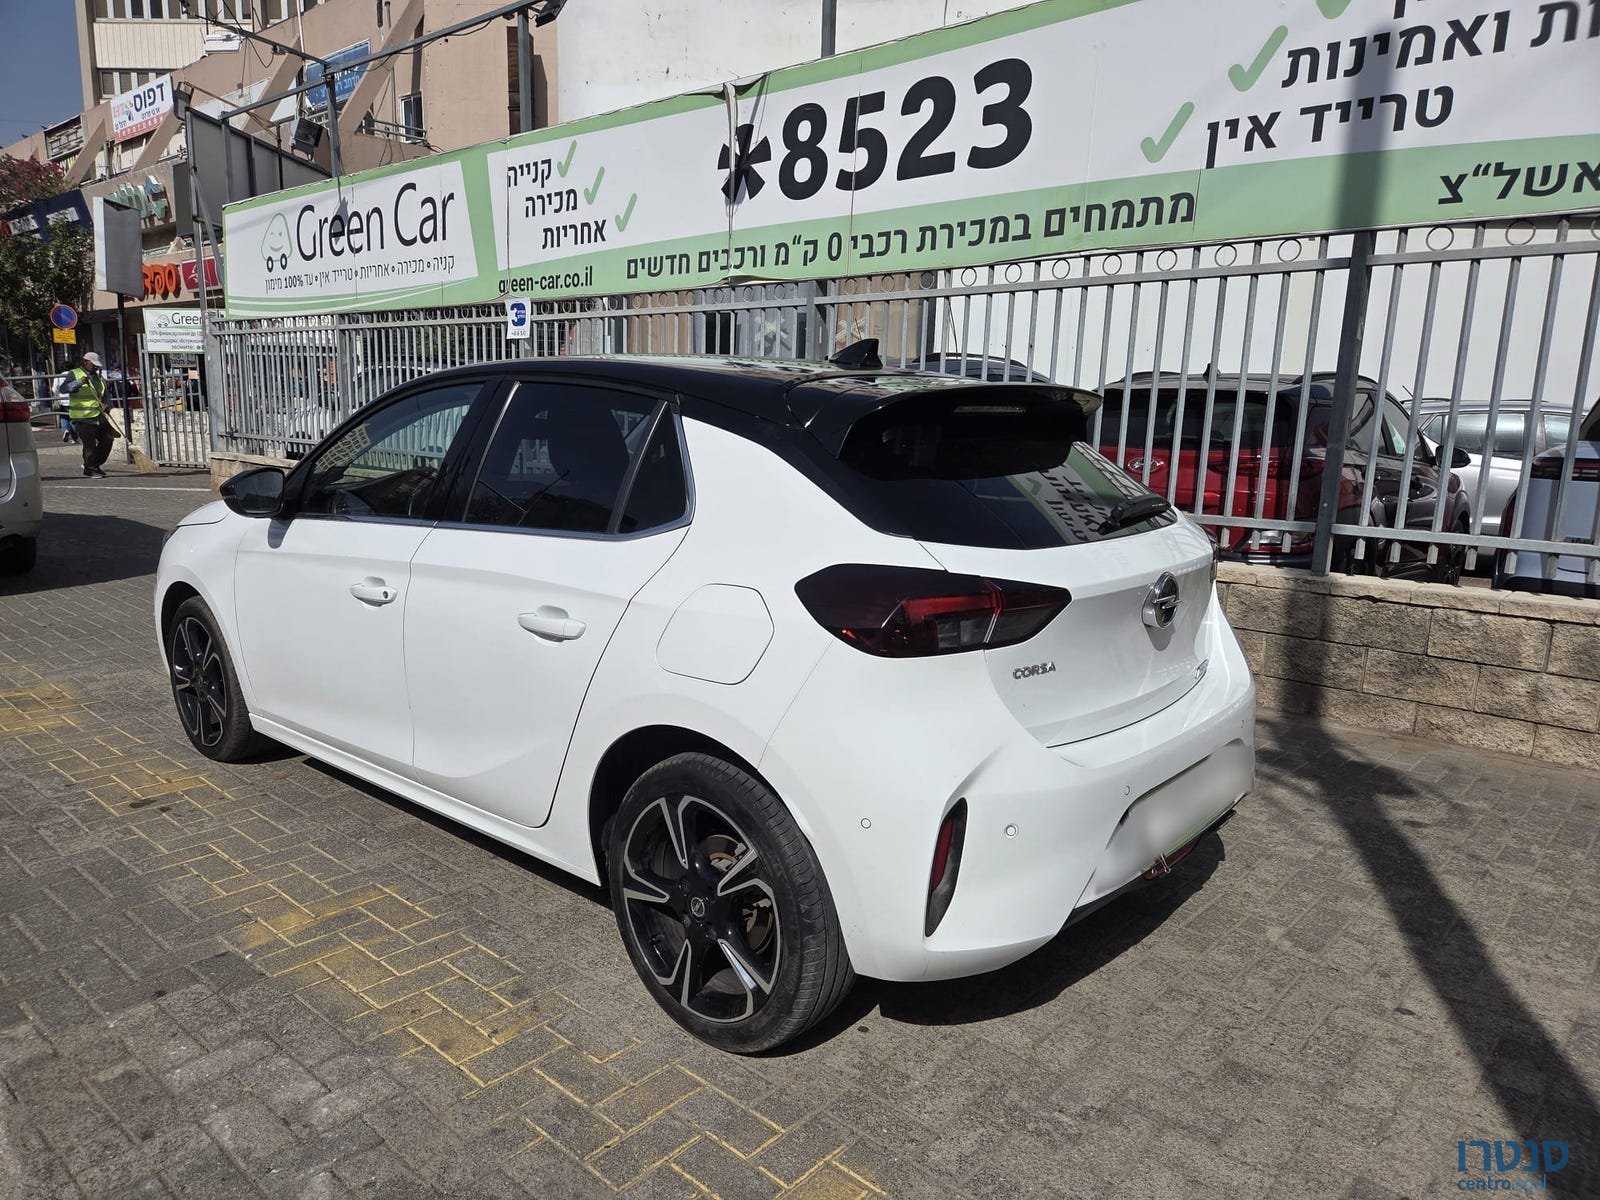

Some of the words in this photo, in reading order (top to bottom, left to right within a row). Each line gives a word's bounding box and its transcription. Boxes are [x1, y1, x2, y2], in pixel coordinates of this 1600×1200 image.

[1282, 10, 1511, 88] ואמינות
[133, 83, 164, 112] דפוס
[1300, 85, 1454, 143] טרייד
[1206, 110, 1281, 169] אין
[507, 158, 552, 188] קנייה
[525, 187, 578, 218] מכירה
[1044, 191, 1195, 238] מתמחים
[296, 204, 384, 262] Green
[394, 182, 455, 247] Car
[542, 218, 607, 250] אחריות
[916, 211, 1032, 252] במכירת
[827, 232, 842, 261] 0
[850, 228, 908, 259] רכבי
[360, 263, 389, 280] אחריות
[397, 259, 425, 276] מכירה
[433, 255, 455, 274] קניה
[626, 252, 690, 280] חדשים
[697, 244, 766, 274] ורכבים
[285, 275, 303, 288] 100%
[332, 267, 353, 283] טרייד
[498, 265, 593, 295] green-car.co.il
[1013, 661, 1056, 680] CORSA
